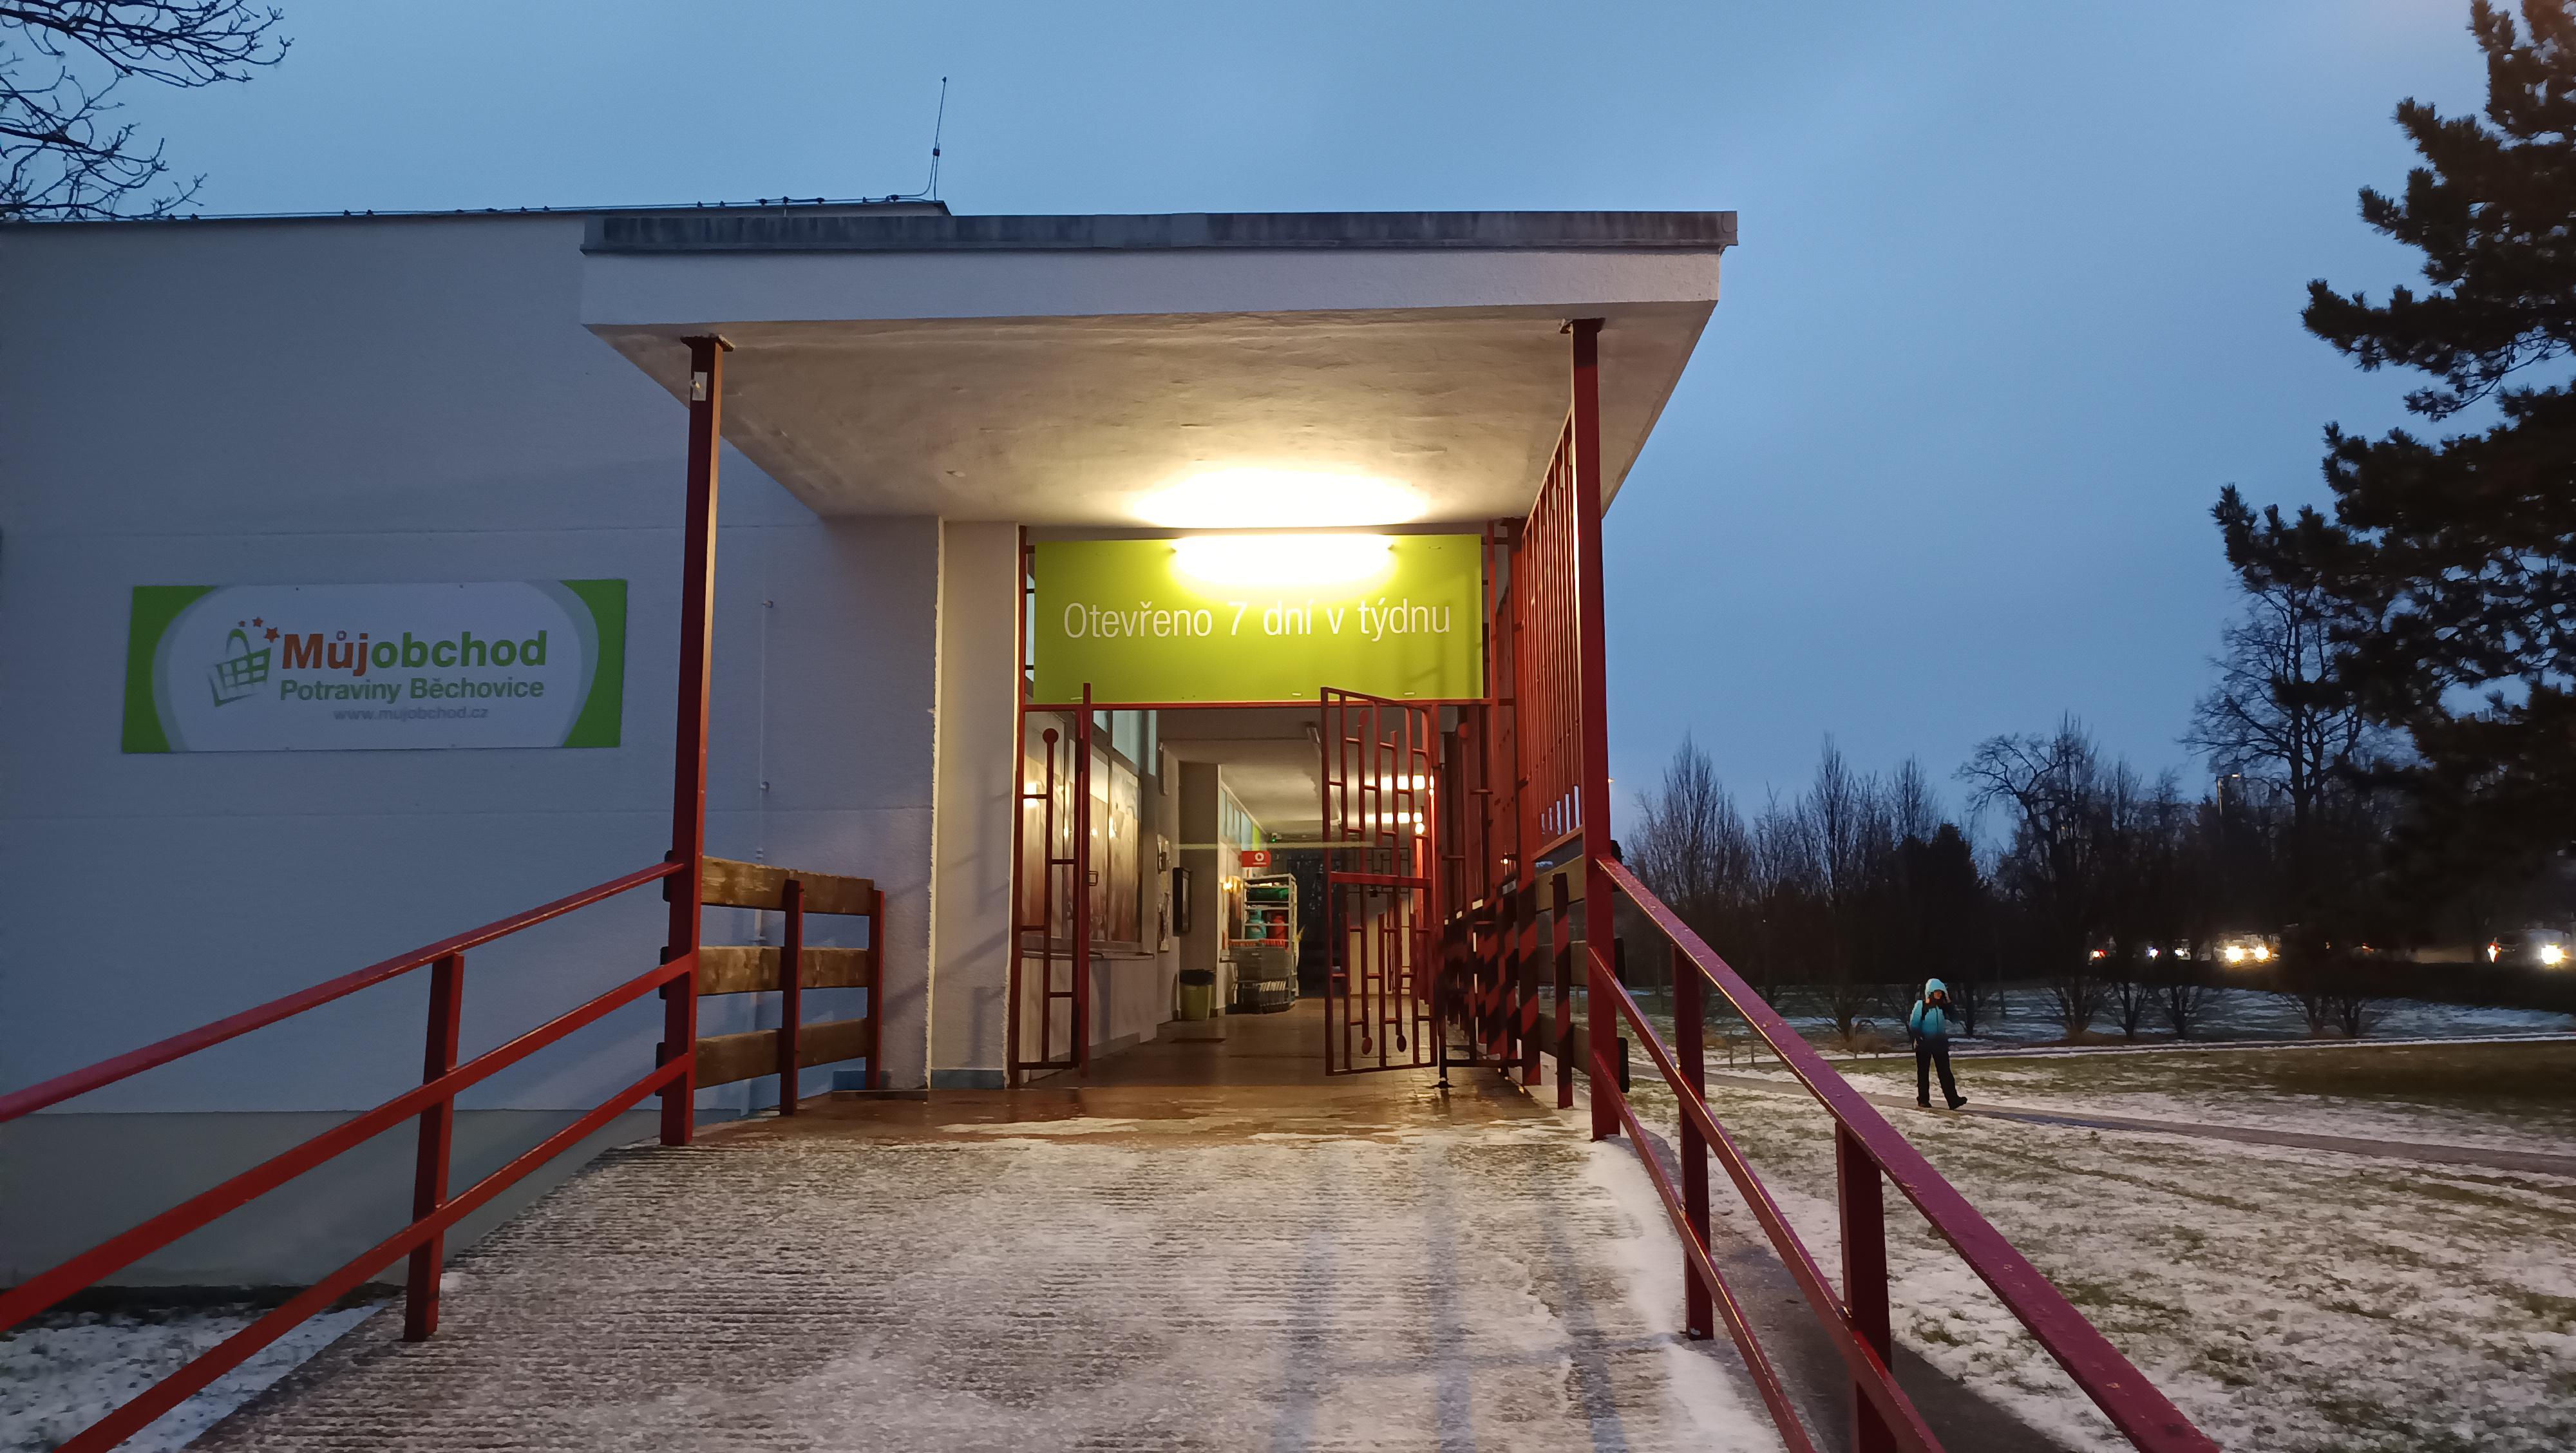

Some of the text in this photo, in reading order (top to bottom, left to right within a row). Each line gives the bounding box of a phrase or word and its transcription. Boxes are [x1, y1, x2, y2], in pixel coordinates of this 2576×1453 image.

[1064, 597, 1450, 641] Otevřeno 7 dní v týdnu
[282, 630, 547, 677] Můjobchod
[280, 677, 545, 705] Potraviny Běchovice
[333, 706, 489, 722] www.mujobchod.cz
